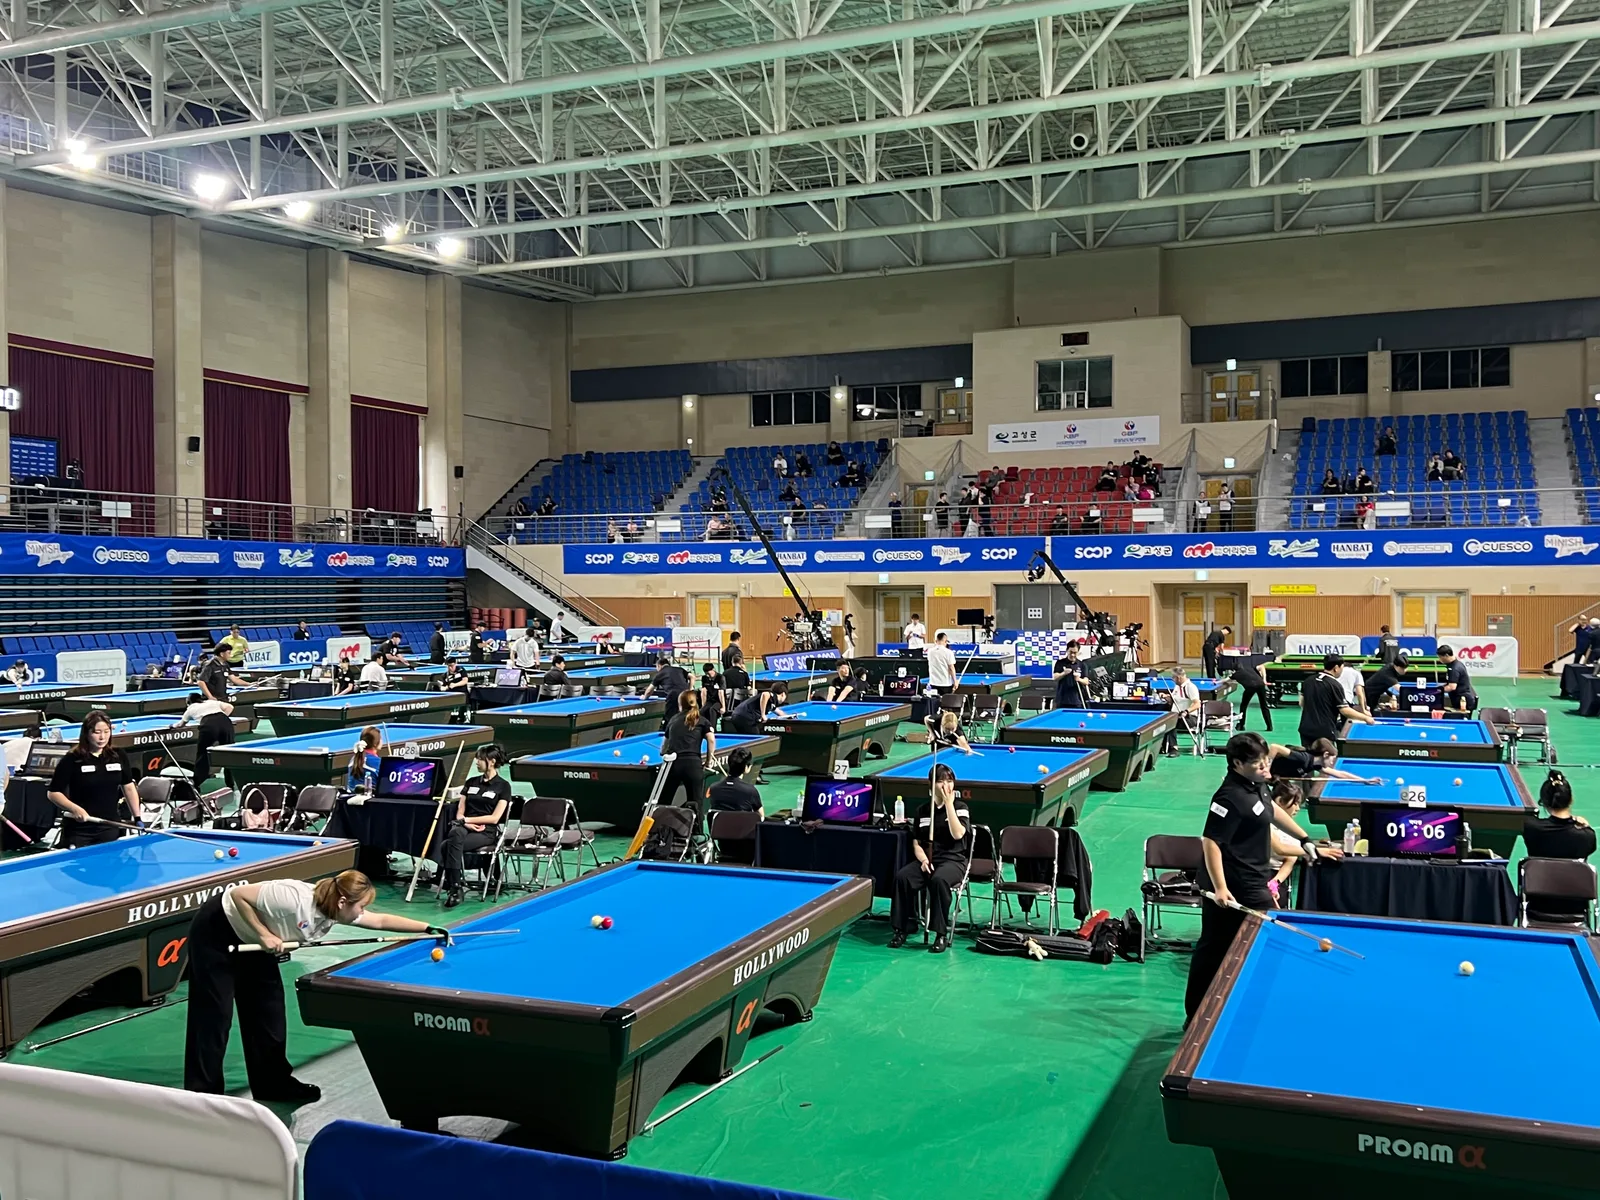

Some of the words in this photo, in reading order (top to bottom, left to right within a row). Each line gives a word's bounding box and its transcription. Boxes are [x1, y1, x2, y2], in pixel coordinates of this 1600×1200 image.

[1332, 544, 1371, 552] HANBAT
[1482, 542, 1531, 551] CUESCO
[1546, 538, 1582, 547] MINISH
[109, 551, 148, 562] CUESCO
[235, 552, 264, 562] HANBAT
[776, 552, 806, 560] HANBAT
[886, 551, 923, 560] CUESCO
[982, 548, 1017, 560] SOOP
[1075, 547, 1112, 559] SOOP
[585, 553, 614, 565] SOOP
[1298, 644, 1347, 655] HANBAT
[19, 691, 67, 700] HOLLYWOOD
[390, 701, 430, 713] HOLLYWOOD
[133, 730, 194, 745] HOLLYWOOD
[1051, 735, 1076, 743] PROAM
[1399, 748, 1429, 757] PROAM
[564, 771, 590, 779] PROAM
[835, 764, 847, 775] 27
[389, 771, 425, 784] 01:58
[818, 792, 859, 808] 01:01
[1386, 822, 1445, 840] 01:06
[733, 927, 810, 986] HOLLYWOOD
[413, 1011, 471, 1033] PROAM
[1358, 1133, 1454, 1164] PROAM
